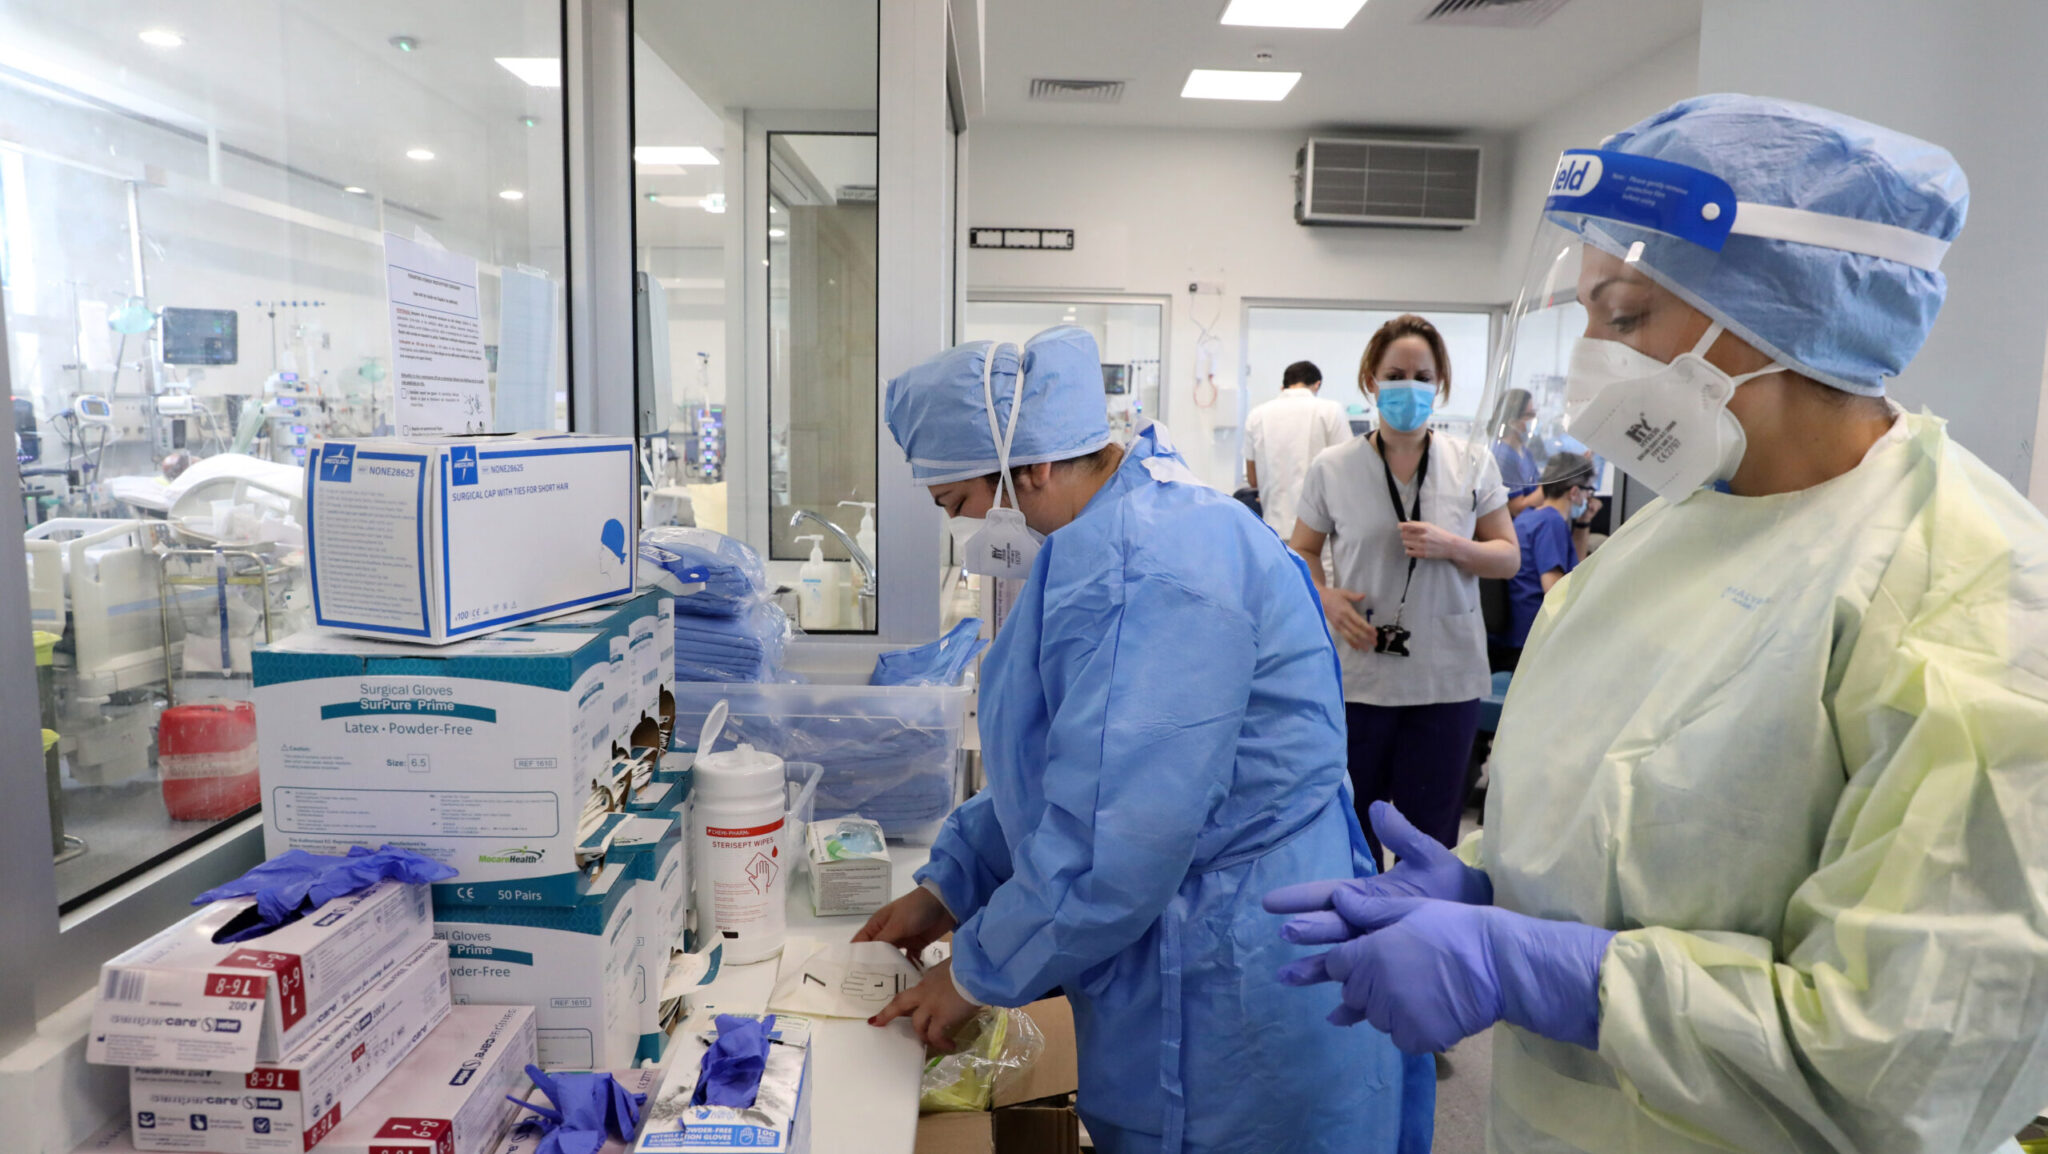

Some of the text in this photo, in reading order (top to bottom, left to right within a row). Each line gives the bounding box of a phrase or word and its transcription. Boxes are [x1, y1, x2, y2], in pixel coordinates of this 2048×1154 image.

[1554, 160, 1591, 190] eld
[369, 466, 415, 478] NONE28625
[452, 482, 569, 501] SURGICAL CAP WITH TIES FOR SHORT HAIR
[360, 683, 453, 697] Surgical Gloves
[360, 698, 455, 711] SurPure Prime
[345, 721, 473, 735] Latex Powder-Free
[411, 758, 427, 767] 6.5
[518, 759, 533, 767] REF
[753, 836, 774, 847] WIPES
[479, 855, 537, 863] MocareHealth
[498, 890, 542, 901] 50 Pairs
[452, 930, 491, 941] Gloves
[457, 944, 493, 955] Prime
[228, 1001, 248, 1010] 200
[703, 1133, 732, 1141] GLOVES
